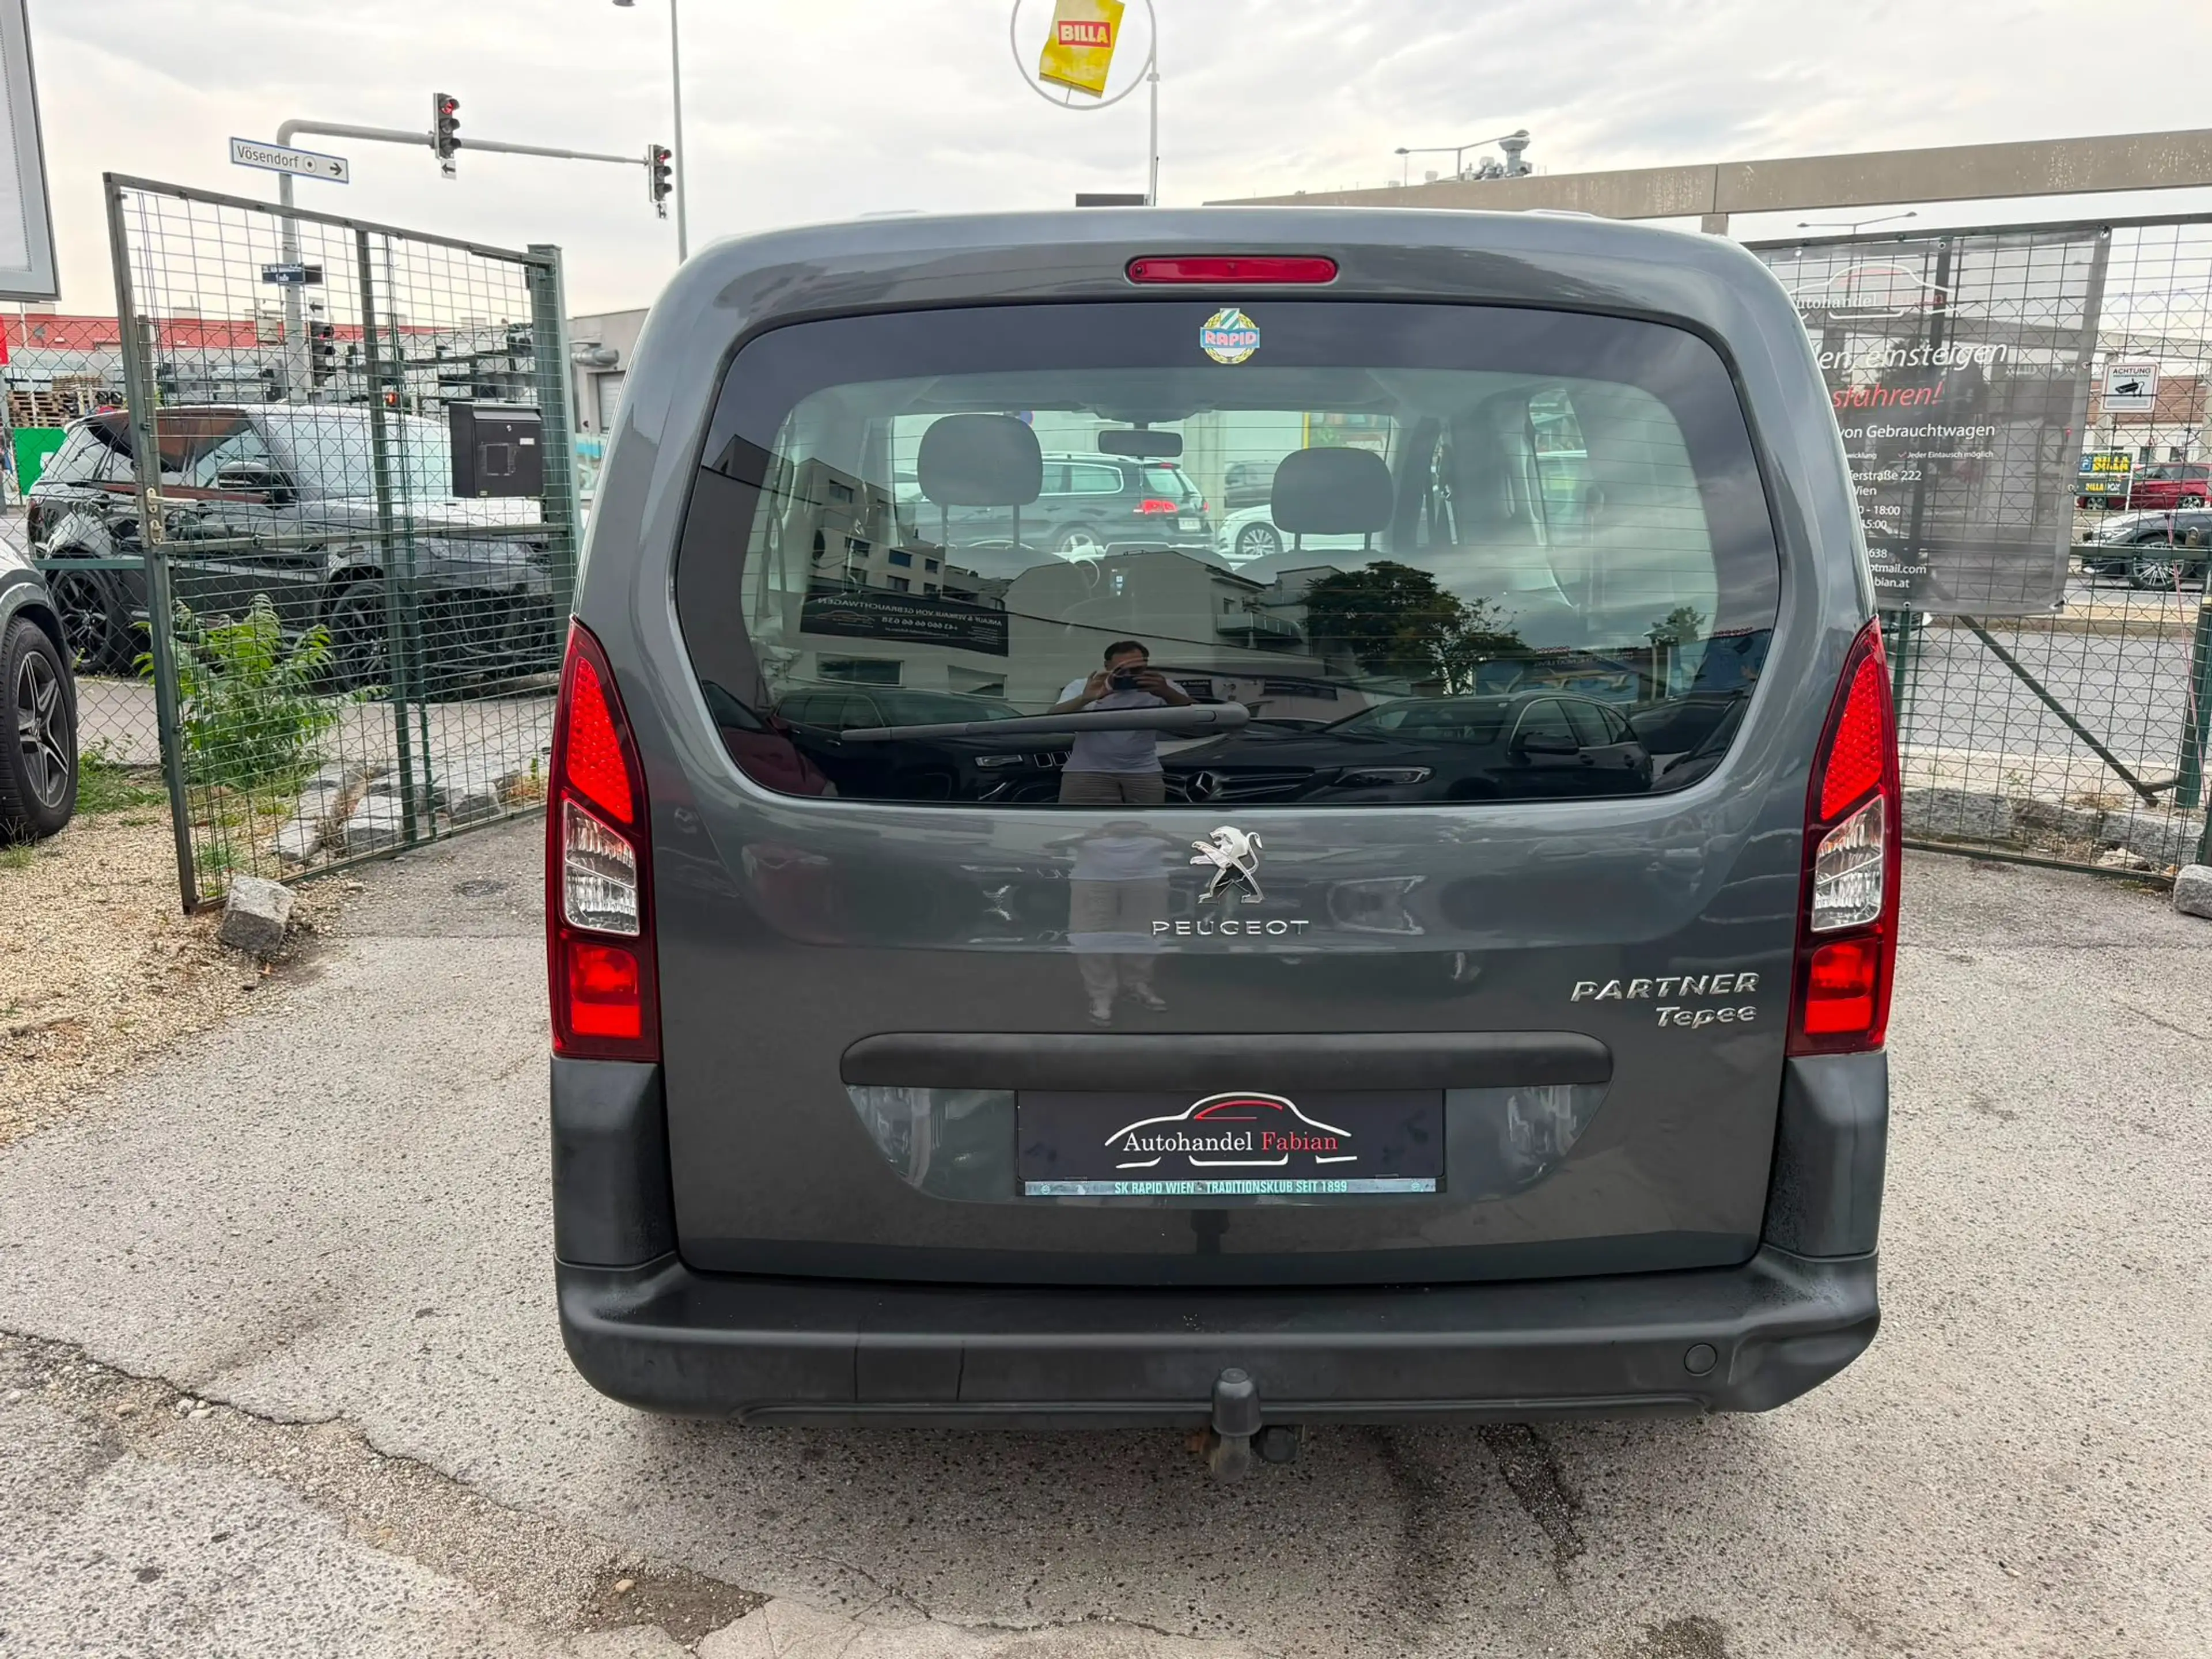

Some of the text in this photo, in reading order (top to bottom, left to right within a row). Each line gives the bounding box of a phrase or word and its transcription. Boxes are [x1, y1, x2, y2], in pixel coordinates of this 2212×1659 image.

[1060, 25, 1108, 43] BILLA
[237, 145, 299, 168] Vösendorf
[1797, 293, 1877, 309] utohandel
[1206, 331, 1256, 346] RAPID
[1817, 342, 2007, 372] en, einsteigen
[1832, 380, 1945, 409] sfahren!
[1866, 423, 1995, 440] Gebrauchtwagen
[1907, 451, 1926, 459] Jeder
[1928, 450, 1962, 459] Eintausch
[1963, 450, 1994, 460] möglich
[1901, 471, 1922, 482] 222
[1874, 506, 1900, 515] 18:00
[1152, 920, 1309, 935] PEUGEOT
[1570, 972, 1759, 1002] PARTNER
[1656, 1006, 1756, 1029] Tepee
[1123, 1131, 1338, 1151] Autohandel Fabian
[1115, 1183, 1128, 1194] SK
[1131, 1183, 1162, 1194] RAPID
[1166, 1183, 1194, 1194] WIEN
[1206, 1182, 1293, 1194] TRADITIONSKLUB
[1296, 1181, 1317, 1193] SEIT
[1321, 1181, 1347, 1193] 1899
